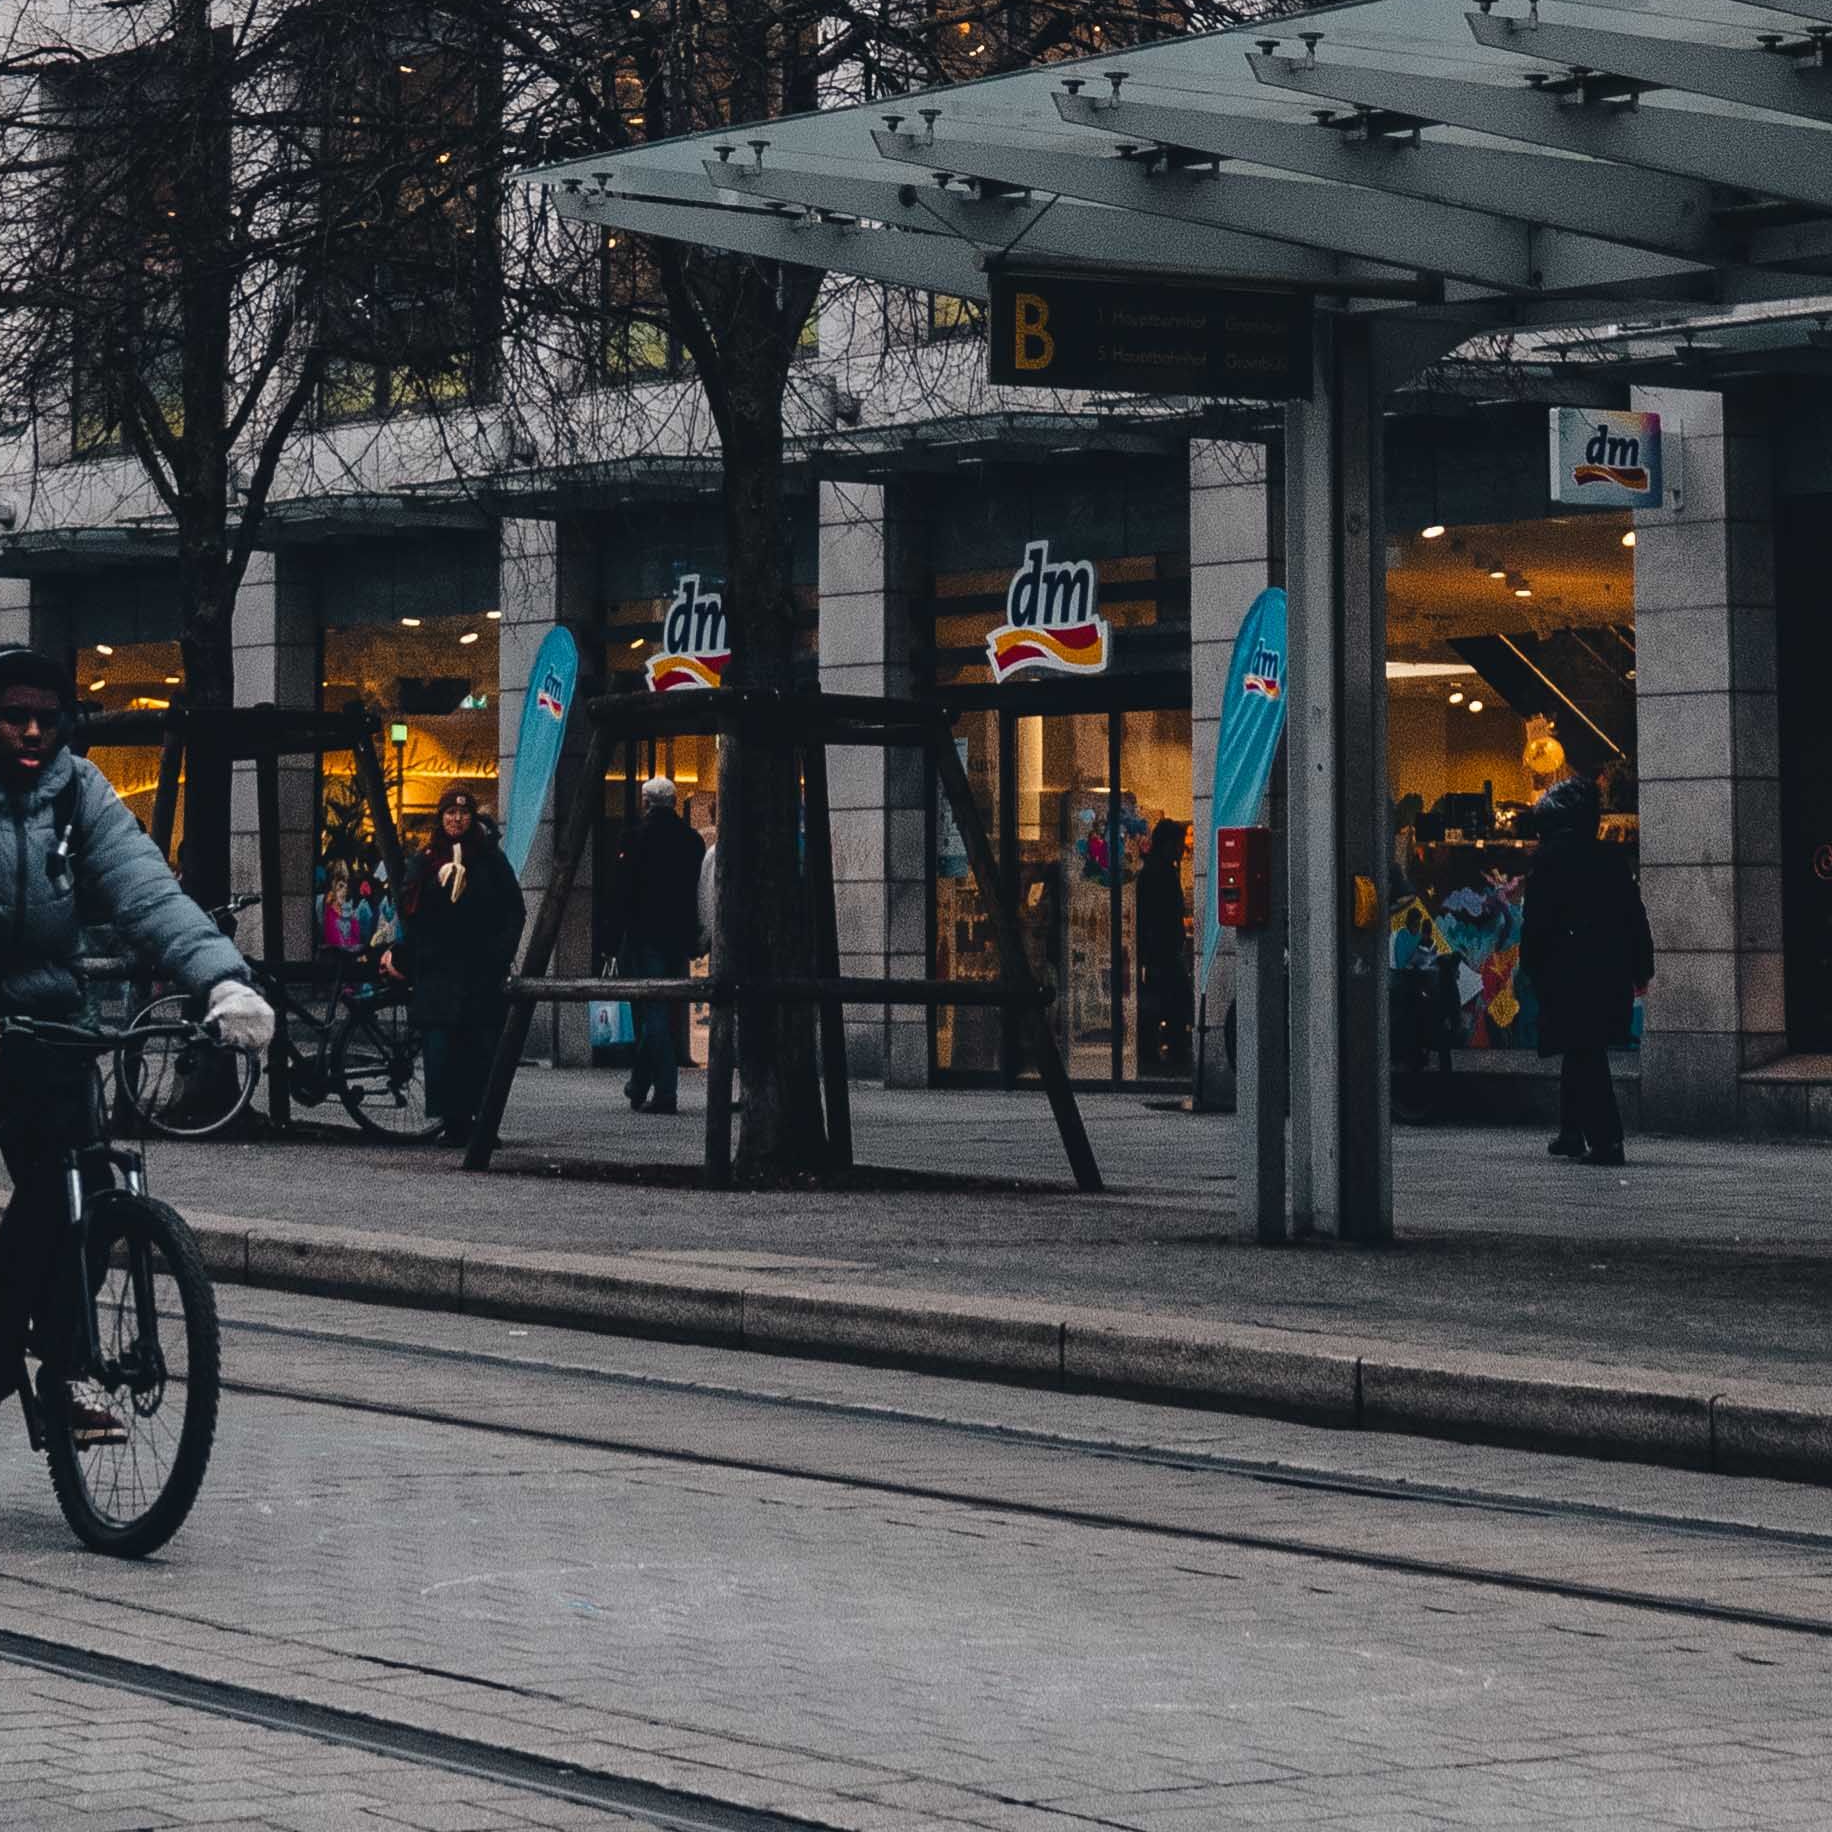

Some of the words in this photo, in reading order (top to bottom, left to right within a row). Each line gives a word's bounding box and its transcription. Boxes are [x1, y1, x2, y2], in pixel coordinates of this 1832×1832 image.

[1014, 291, 1056, 371] B
[1585, 425, 1640, 466] dm
[1011, 548, 1091, 627] dm
[668, 581, 725, 654] dm
[544, 665, 562, 701] dm
[1252, 640, 1278, 679] dm
